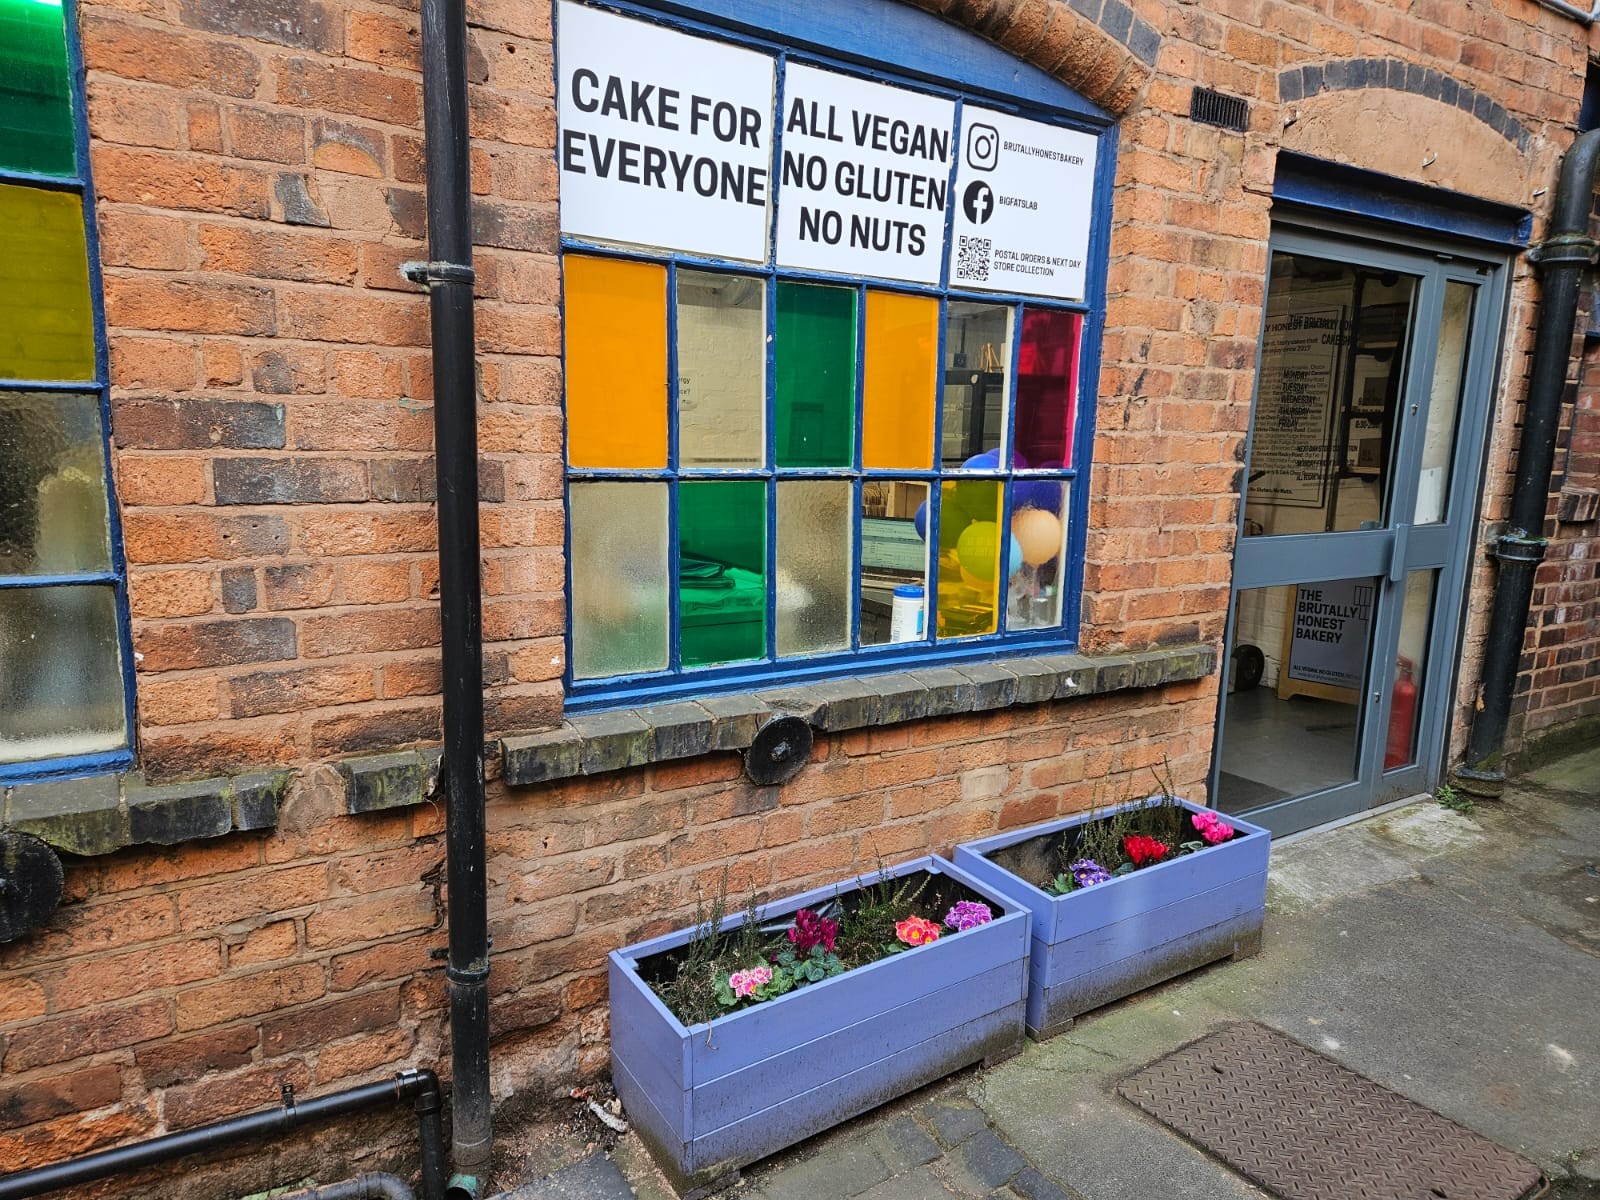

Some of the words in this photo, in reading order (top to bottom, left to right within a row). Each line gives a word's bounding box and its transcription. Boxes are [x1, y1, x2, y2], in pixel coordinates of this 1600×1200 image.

[571, 68, 680, 132] CAKE
[690, 94, 762, 149] FOR
[786, 97, 844, 143] ALL
[852, 109, 949, 163] VEGAN
[1003, 140, 1084, 166] BRUTALLYHONESTBAKERY
[563, 128, 767, 207] EVERYONE
[782, 150, 827, 191] NO
[834, 160, 947, 212] GLUTEN
[999, 195, 1038, 211] BIGFATSLAB
[799, 206, 843, 245] NO
[850, 214, 927, 257] NUTS
[994, 249, 1019, 262] POSTAL
[1020, 253, 1046, 265] ORDERS
[1046, 256, 1051, 265] &
[1051, 257, 1068, 268] NEXT
[1068, 260, 1081, 269] DAY
[993, 261, 1015, 273] STORE
[1015, 263, 1054, 277] COLLECTION
[1282, 382, 1307, 392] TUESDAY
[1300, 589, 1322, 602] THE
[1298, 602, 1358, 618] BRUTALLY
[1297, 614, 1345, 630] HONEST
[1296, 628, 1342, 643] BAKERY
